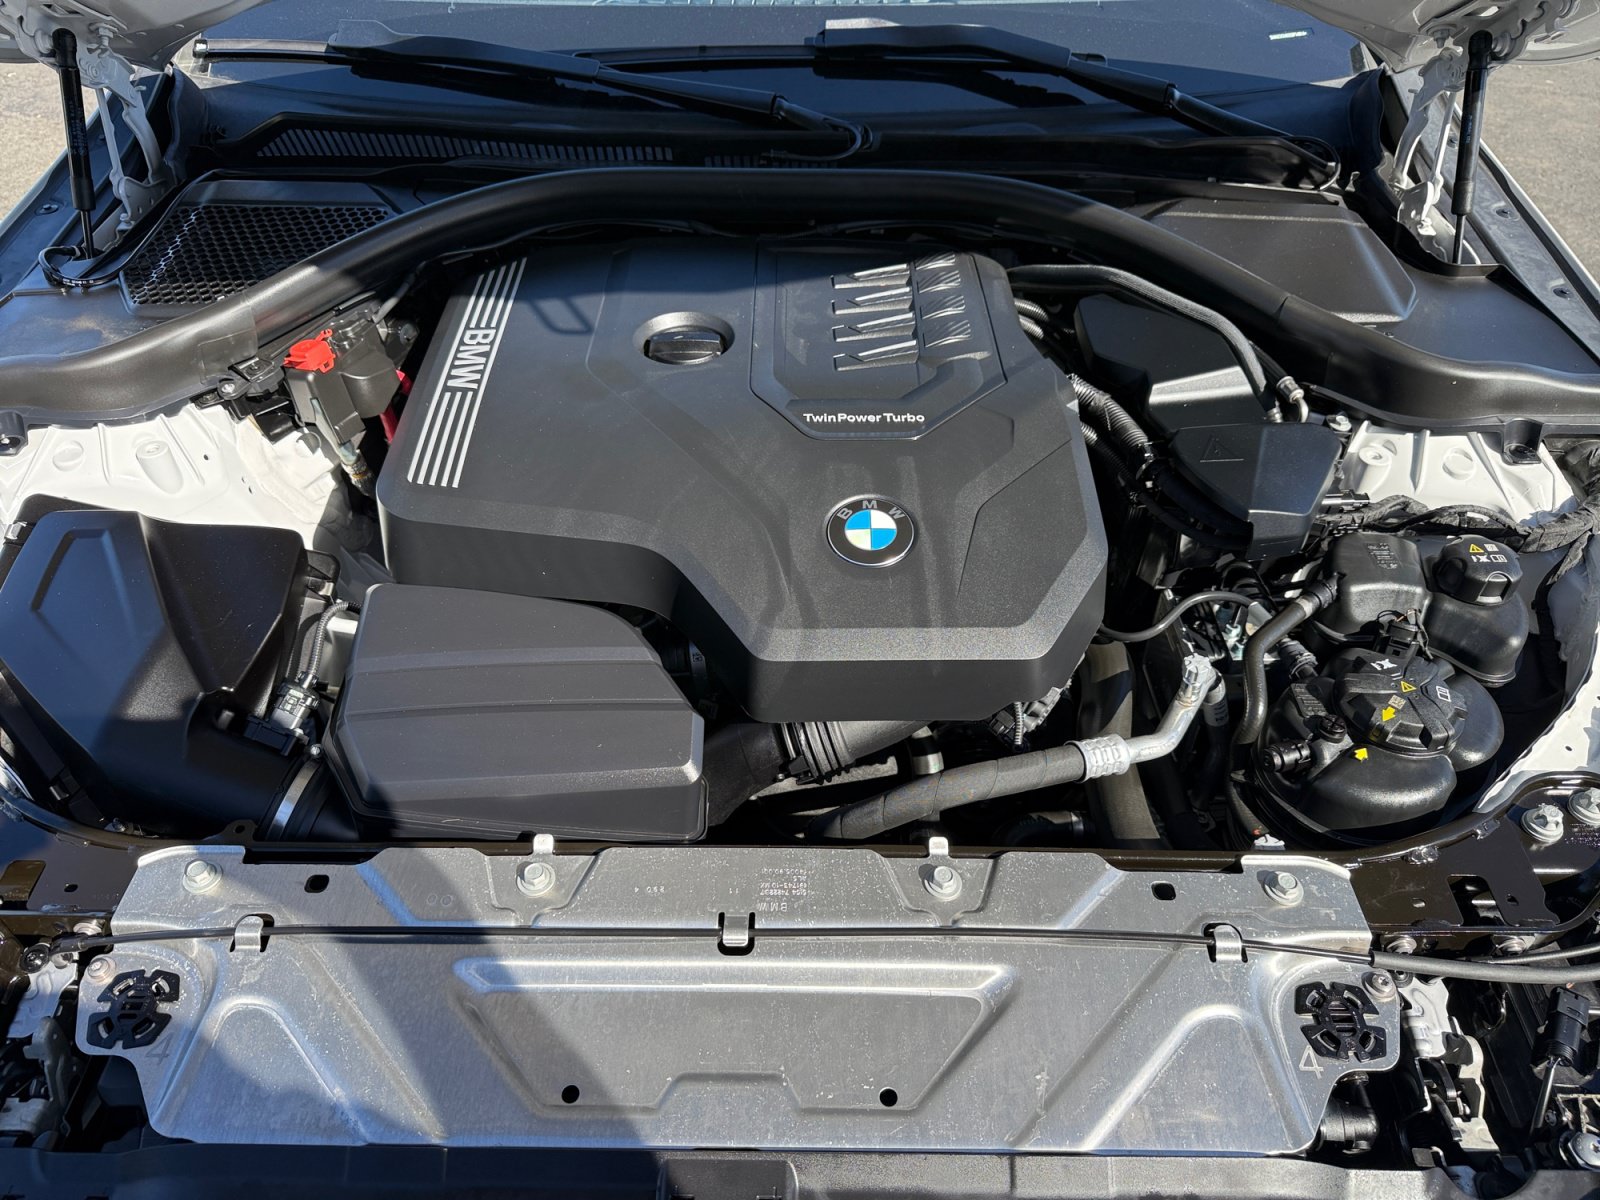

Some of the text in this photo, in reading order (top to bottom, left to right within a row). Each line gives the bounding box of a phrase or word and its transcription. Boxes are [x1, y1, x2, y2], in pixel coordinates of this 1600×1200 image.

[446, 328, 497, 389] BMW
[882, 413, 926, 423] Turbo
[837, 499, 906, 520] BMW
[757, 902, 788, 912] BMW
[1298, 1044, 1324, 1080] 4
